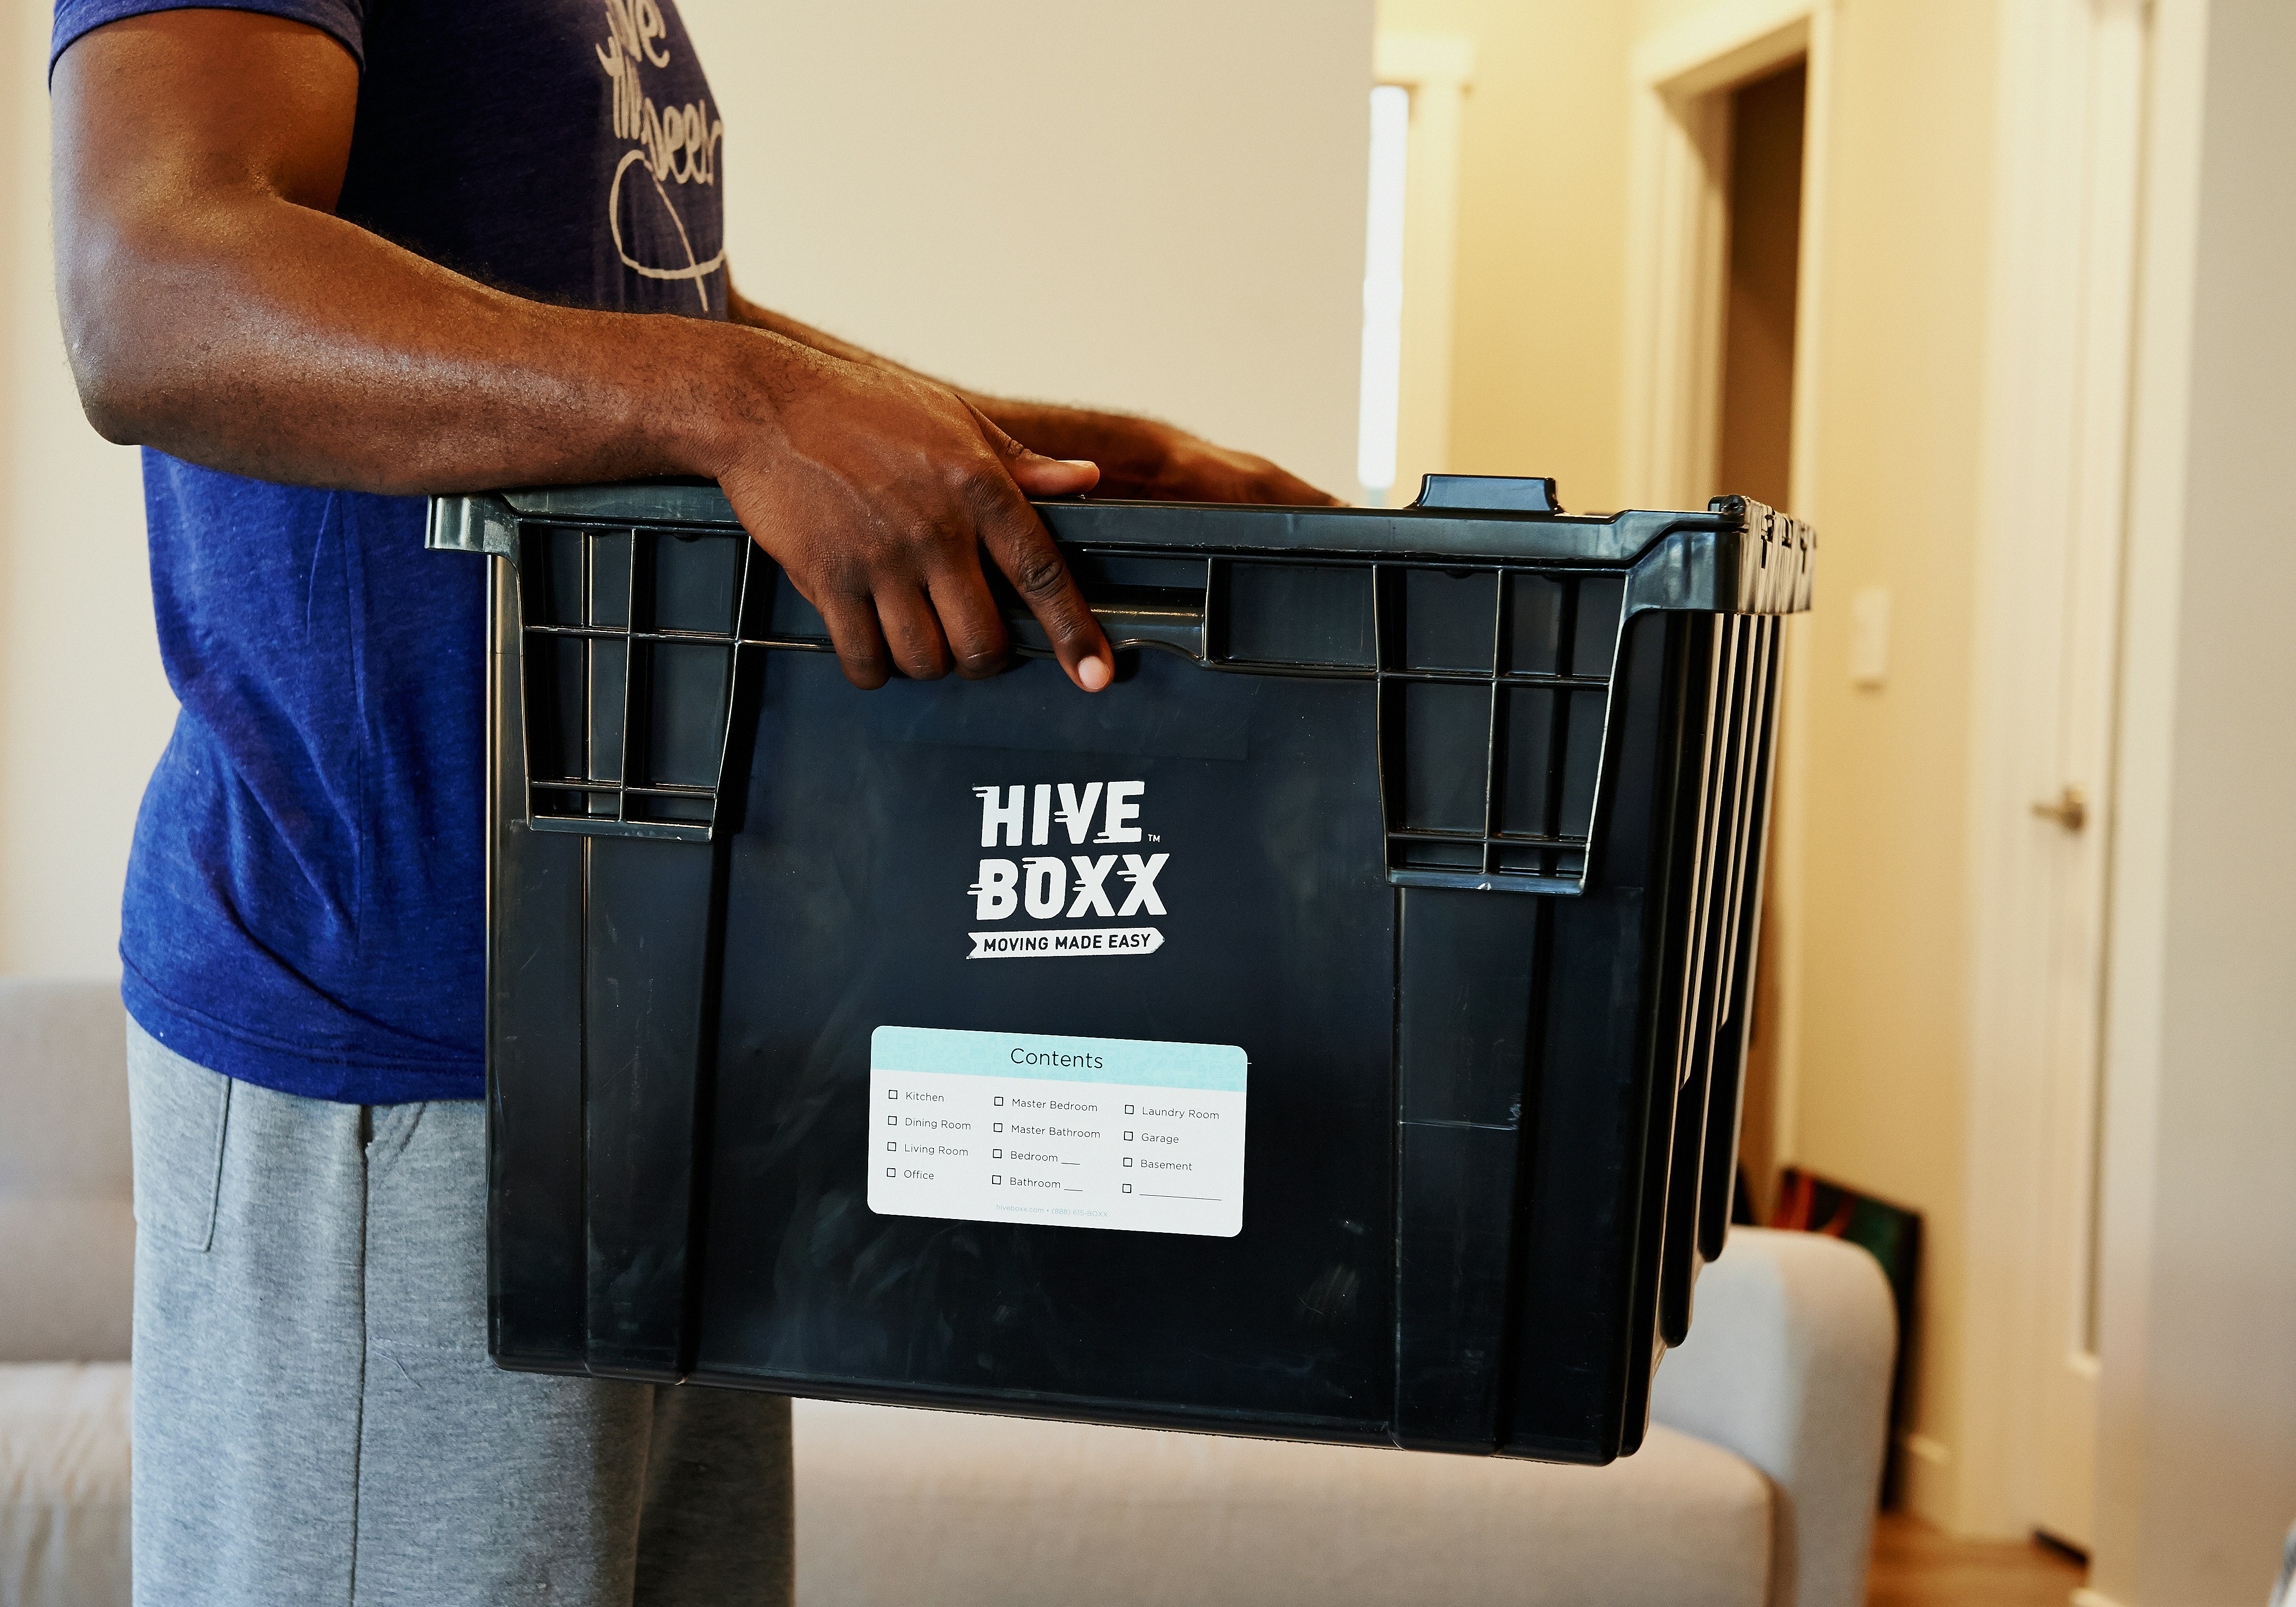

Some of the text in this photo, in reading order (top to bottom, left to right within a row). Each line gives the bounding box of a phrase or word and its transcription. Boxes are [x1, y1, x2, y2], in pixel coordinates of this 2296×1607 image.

[972, 781, 1145, 847] HIVE
[967, 853, 1170, 920] BOXX
[984, 933, 1151, 952] MOVING MADE EASY
[1011, 1048, 1103, 1069] Contents
[905, 1091, 944, 1102] Kitchen
[1012, 1098, 1098, 1112] Master Bedroom
[1142, 1106, 1220, 1120] Laundry Room
[905, 1117, 971, 1130] Dining Room
[1011, 1125, 1101, 1138] Master Bathroom
[1141, 1133, 1179, 1144] Garage
[904, 1144, 969, 1157] Living Room
[1011, 1151, 1058, 1163] Bedroom
[1140, 1159, 1193, 1171] Basement
[904, 1170, 934, 1180] Office
[1010, 1177, 1061, 1189] Bathroom
[996, 1204, 1044, 1213] hiveboxx.com
